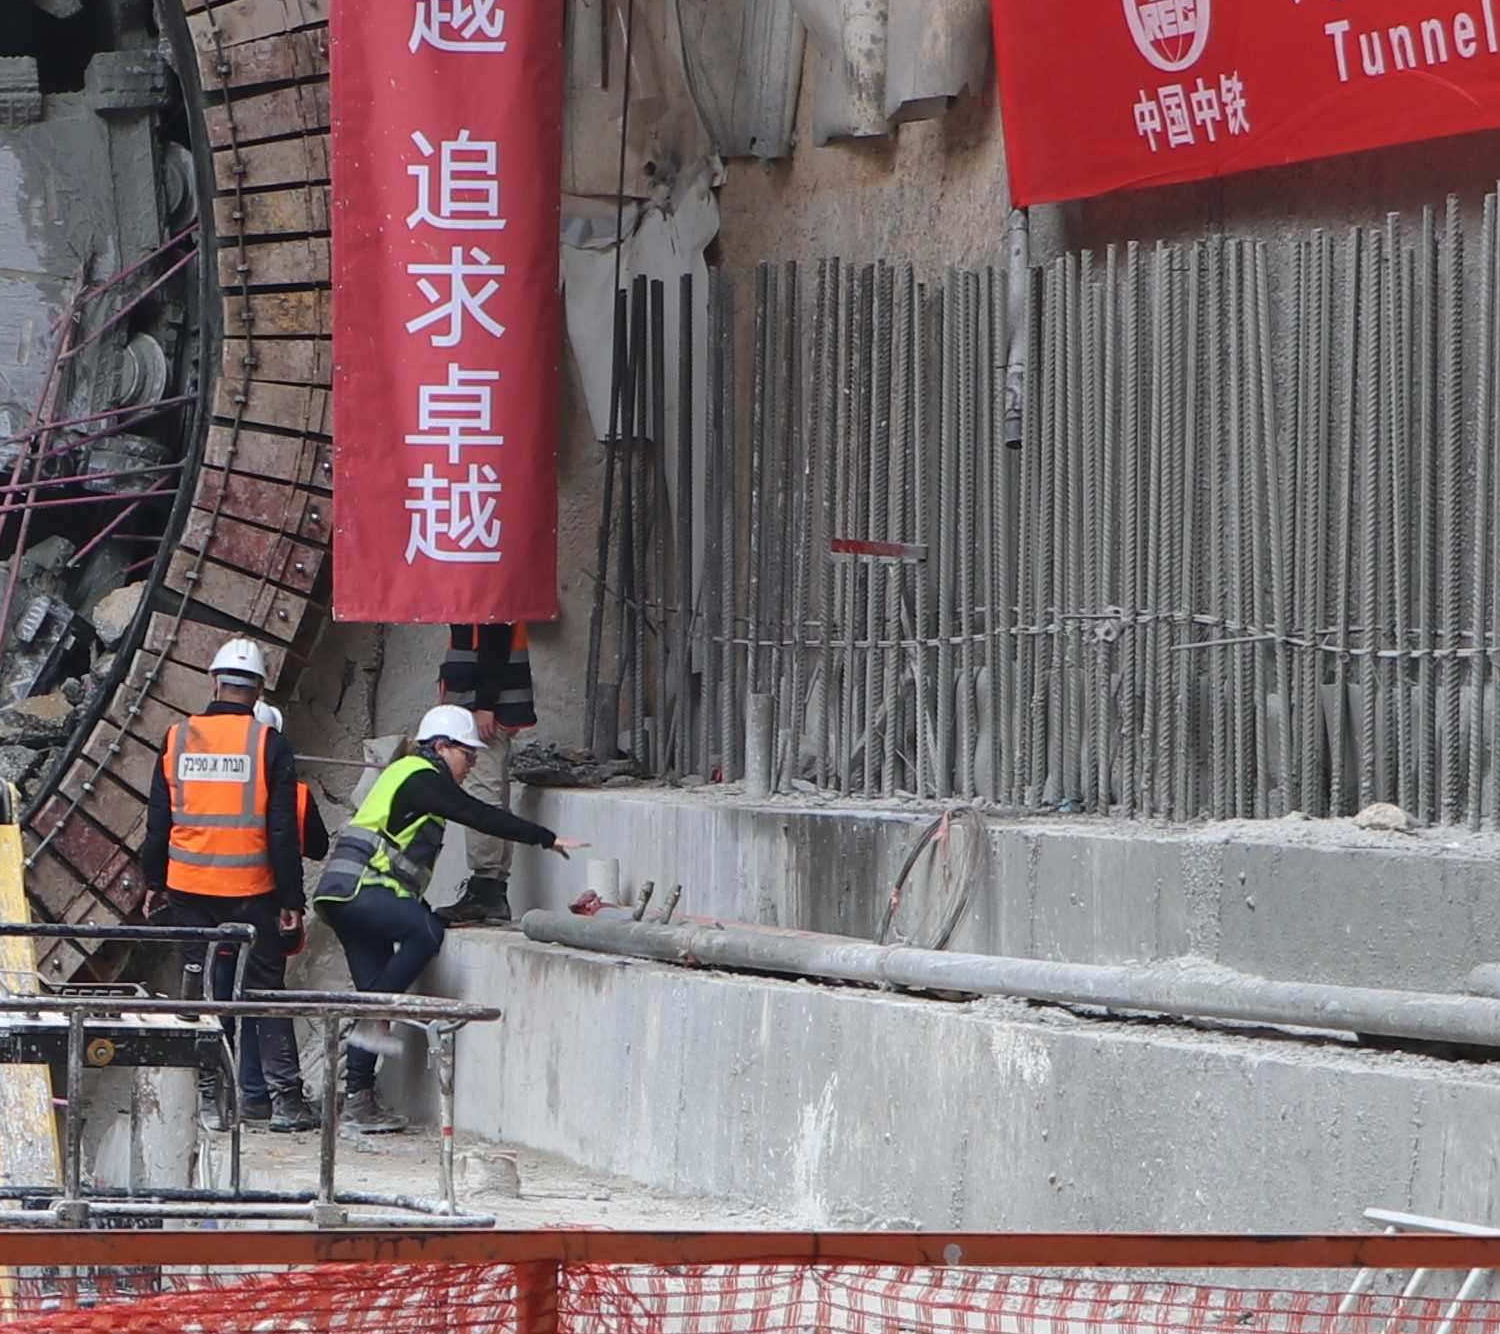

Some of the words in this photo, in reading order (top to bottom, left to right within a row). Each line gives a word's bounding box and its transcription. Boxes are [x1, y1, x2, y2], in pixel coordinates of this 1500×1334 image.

[1132, 70, 1251, 153] 中国中铁
[404, 129, 509, 566] 追求卓越
[223, 758, 244, 772] חברת
